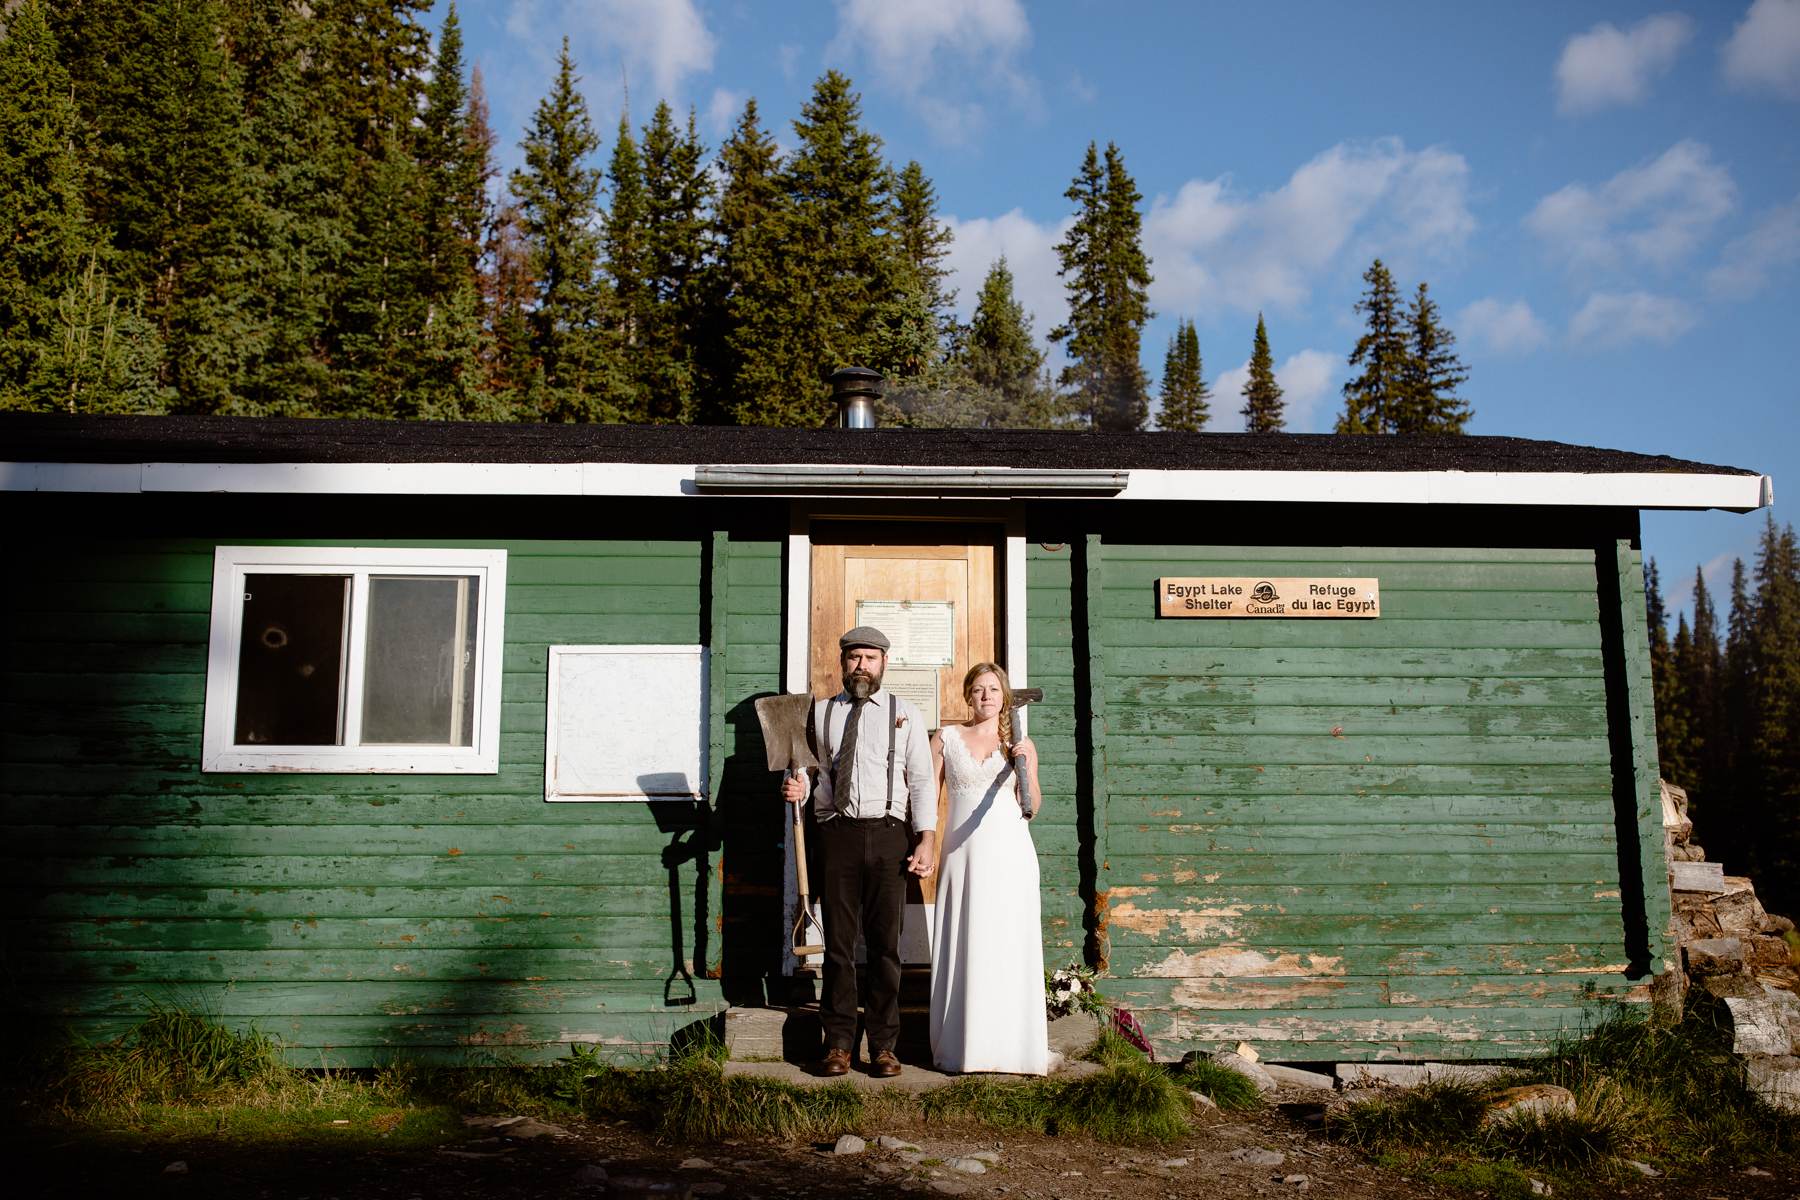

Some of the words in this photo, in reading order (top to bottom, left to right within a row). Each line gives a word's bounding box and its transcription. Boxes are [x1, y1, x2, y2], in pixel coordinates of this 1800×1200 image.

[1167, 584, 1207, 597] Egypt
[1211, 584, 1243, 595] Lake
[1309, 584, 1356, 597] Refuge
[1185, 599, 1233, 610] Shelter
[1246, 603, 1285, 614] Canada
[1291, 599, 1308, 610] du
[1312, 599, 1332, 610] lac
[1337, 599, 1376, 613] Egypt
